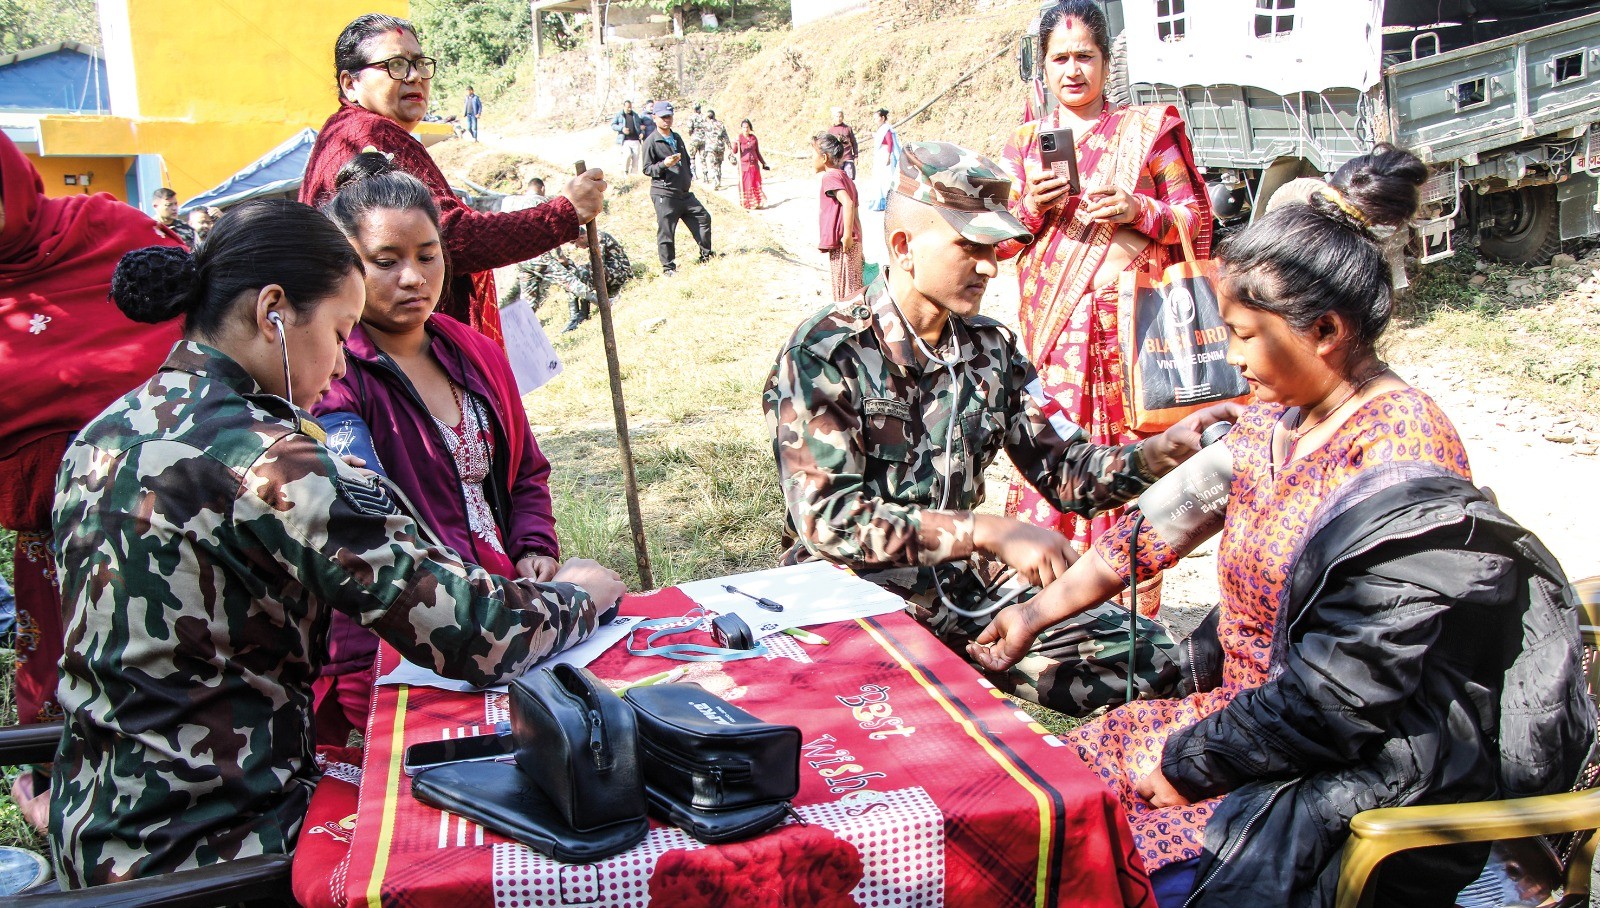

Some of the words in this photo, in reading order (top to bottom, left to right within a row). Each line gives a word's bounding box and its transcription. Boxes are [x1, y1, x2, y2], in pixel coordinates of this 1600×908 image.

[1145, 333, 1193, 353] BLAK
[1194, 325, 1228, 346] BIRD
[1156, 353, 1198, 370] VINTE
[1197, 350, 1225, 364] DENIM
[1169, 500, 1194, 521] CUFF
[835, 684, 916, 740] Best
